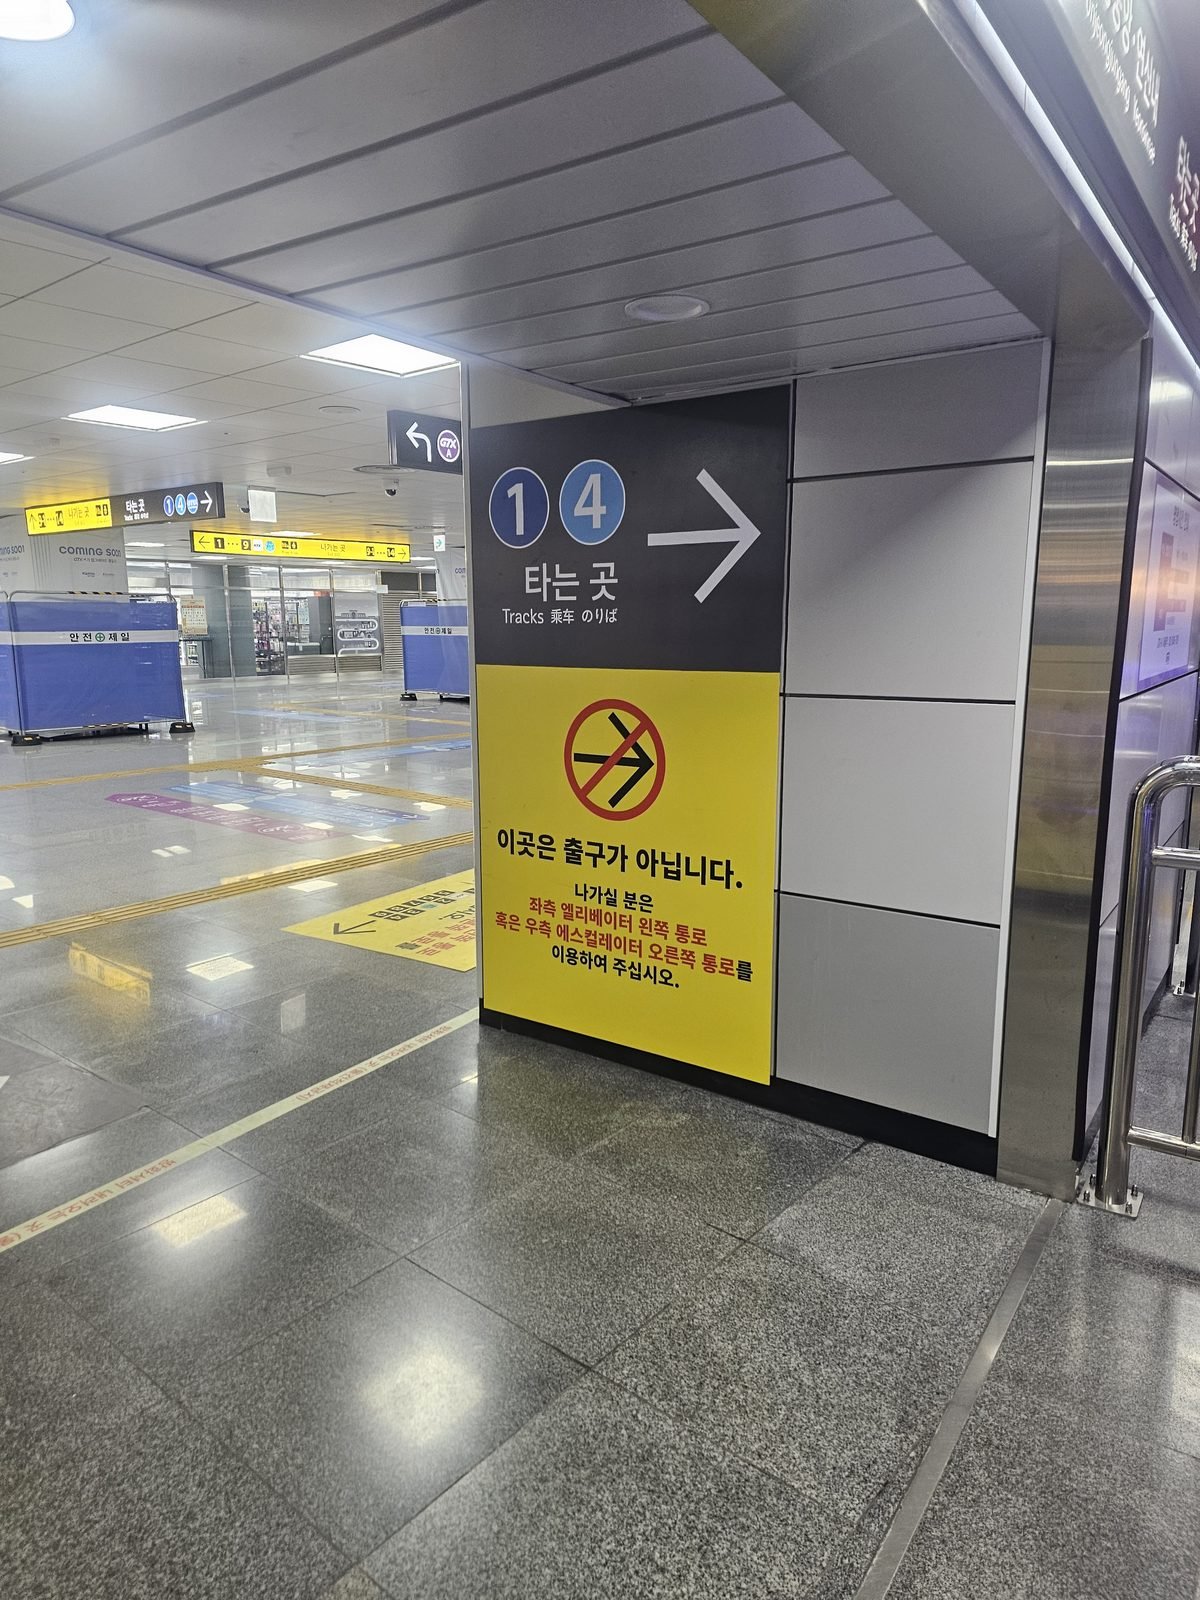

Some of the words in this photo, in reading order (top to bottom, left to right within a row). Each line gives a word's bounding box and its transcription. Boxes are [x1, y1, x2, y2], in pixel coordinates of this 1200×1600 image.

[440, 437, 457, 449] GTX
[446, 448, 452, 458] A
[125, 499, 138, 513] 타는
[138, 498, 145, 512] 곳
[507, 482, 524, 536] 1
[574, 473, 607, 529] 4
[525, 562, 579, 602] 타는
[589, 562, 618, 601] 곳
[502, 608, 544, 624] Tracks
[551, 608, 575, 624] 乘车
[581, 607, 618, 624] のりば
[70, 632, 92, 642] 안전
[497, 828, 557, 861] 이곳은
[563, 837, 628, 873] 출구가
[636, 849, 743, 889] 아닙니다.
[574, 883, 618, 908] 나가실
[623, 890, 654, 914] 분은
[529, 896, 557, 918] 좌측
[561, 902, 633, 934] 엘리베이터
[638, 917, 669, 941] 왼쪽
[674, 923, 708, 947] 통로
[495, 911, 521, 932] 혹은
[525, 917, 552, 939] 우측
[556, 923, 643, 959] 에스컬레이터
[648, 943, 697, 970] 오른쪽
[701, 953, 754, 983] 통로를
[551, 944, 607, 974] 이용하여
[612, 956, 680, 989] 주십시오.
